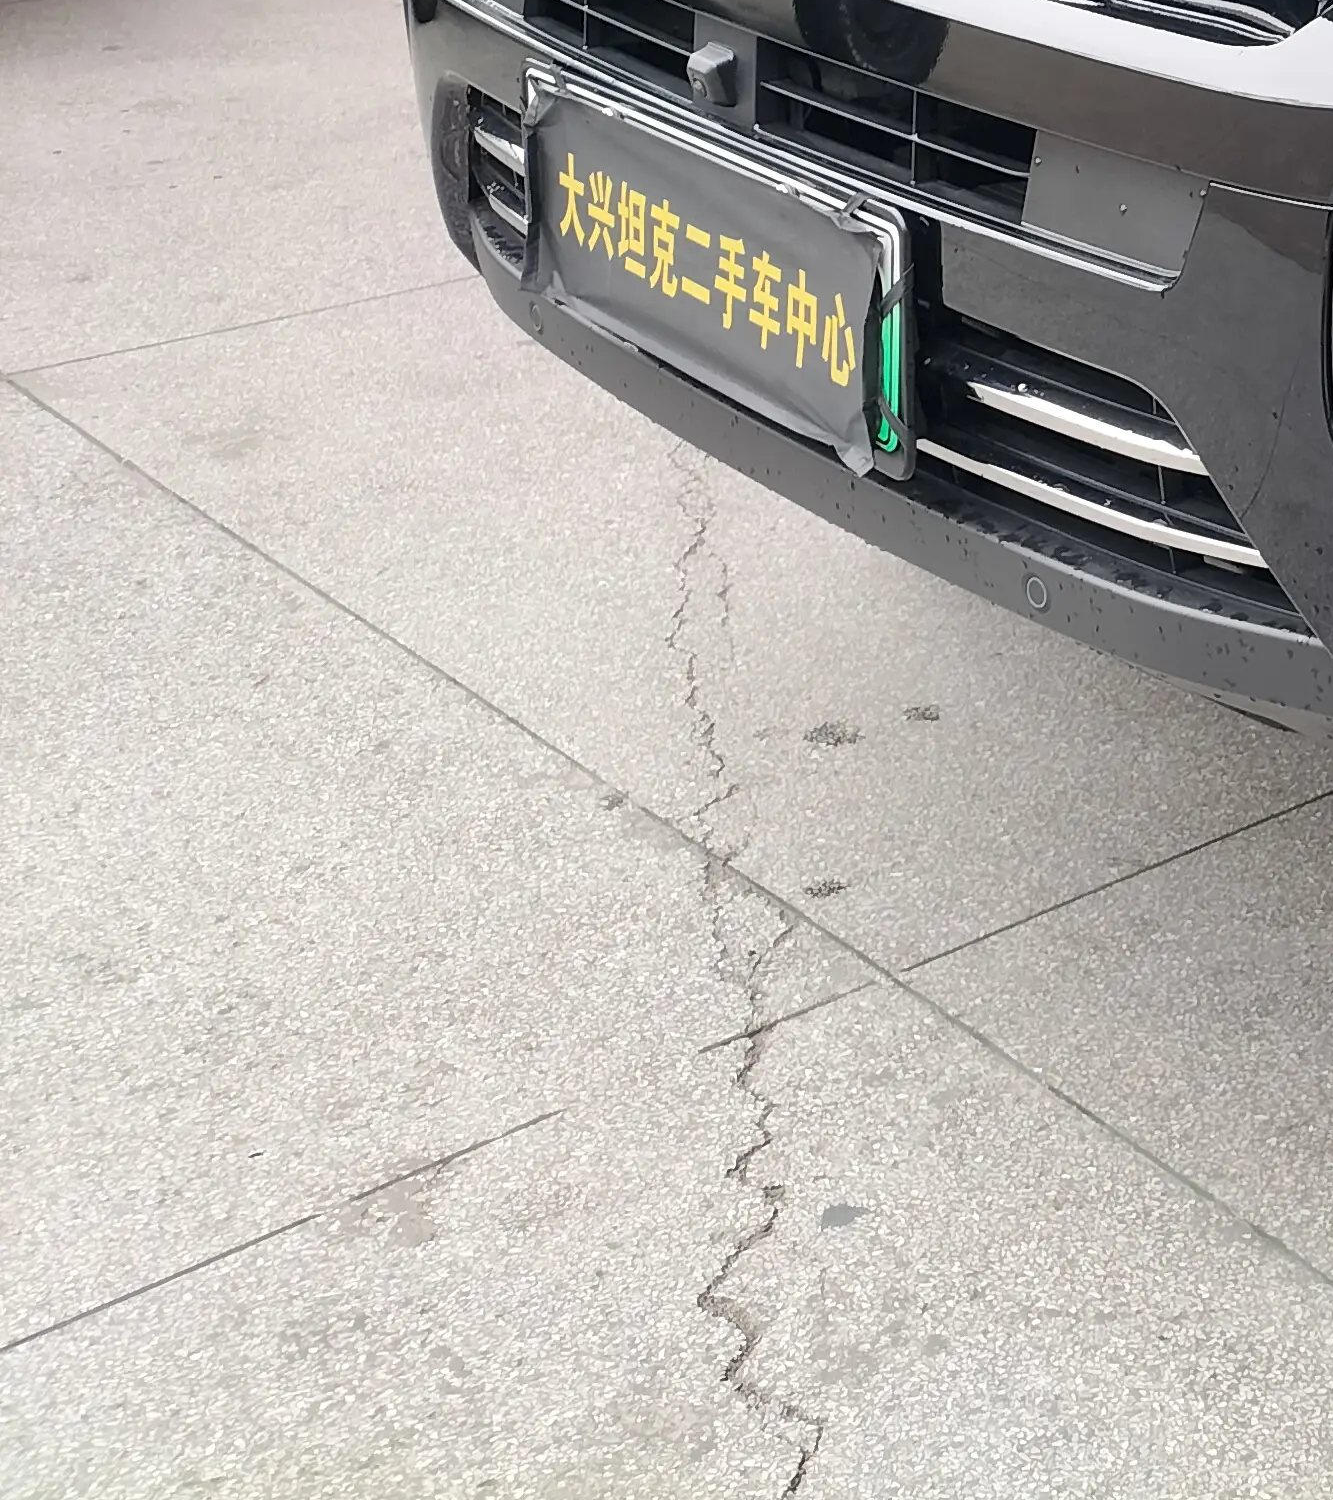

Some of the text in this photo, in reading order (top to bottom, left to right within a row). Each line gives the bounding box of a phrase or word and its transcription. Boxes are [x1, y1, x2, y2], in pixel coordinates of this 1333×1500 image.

[558, 152, 857, 388] 大兴坦克二手车中心
